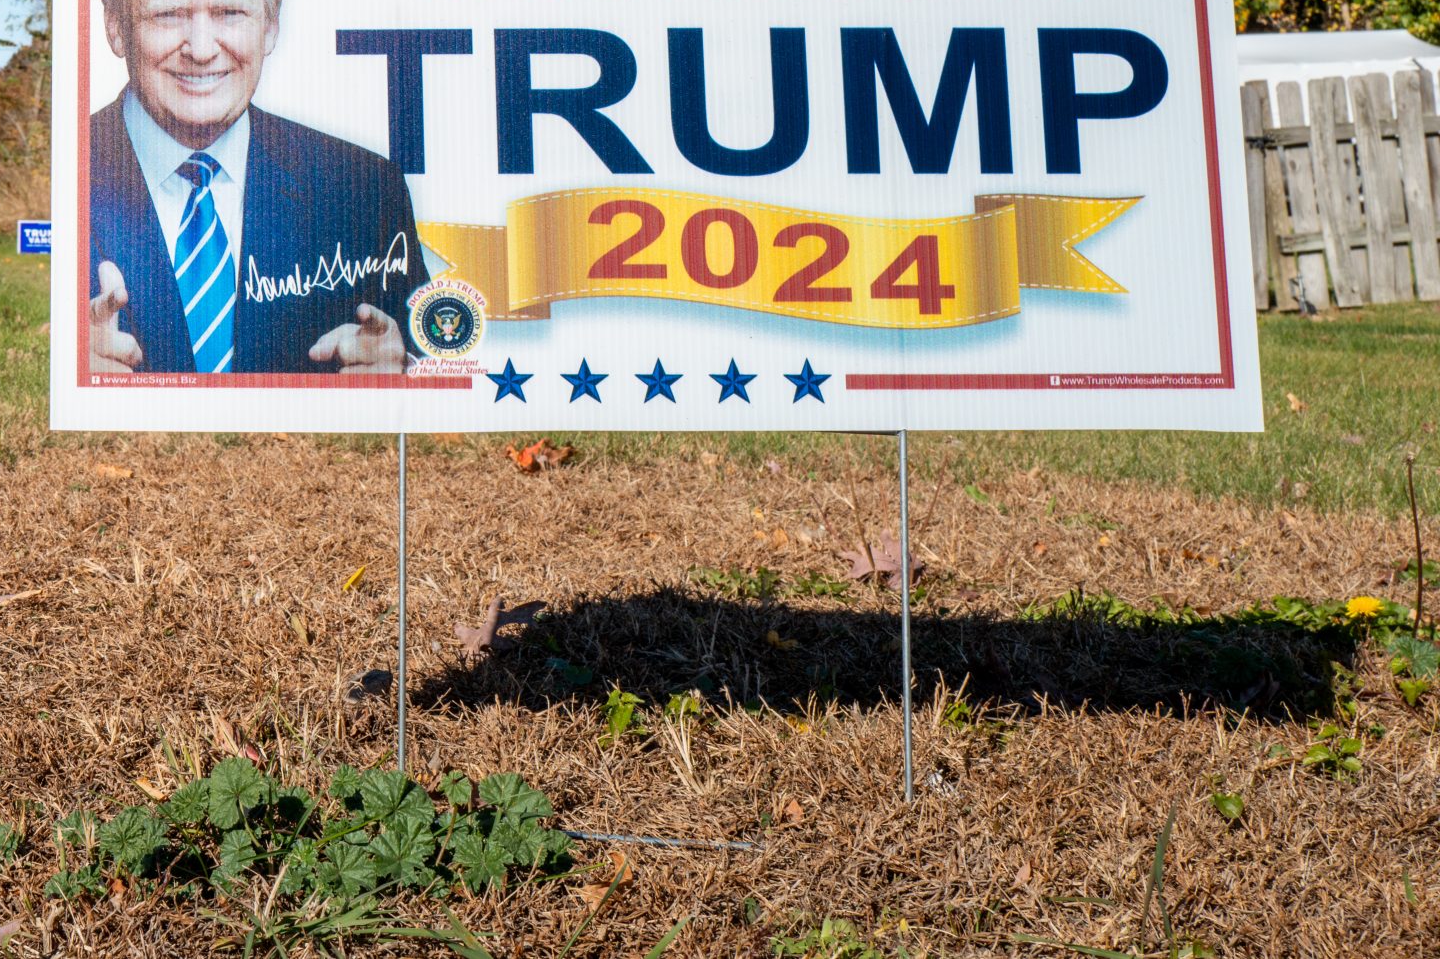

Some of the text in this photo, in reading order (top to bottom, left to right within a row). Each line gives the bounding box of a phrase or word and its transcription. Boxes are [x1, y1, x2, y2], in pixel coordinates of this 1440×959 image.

[335, 27, 1169, 176] TRUMP
[587, 199, 956, 315] 2024
[408, 281, 444, 307] DONALD
[456, 282, 486, 307] TRUMP
[415, 290, 446, 322] PRESIDENT
[466, 300, 480, 330] UNITED
[455, 333, 479, 355] STATES
[409, 367, 418, 376] of
[420, 358, 479, 366] 45th President
[1061, 375, 1225, 387] www.TrumpWholesaleProducts.com
